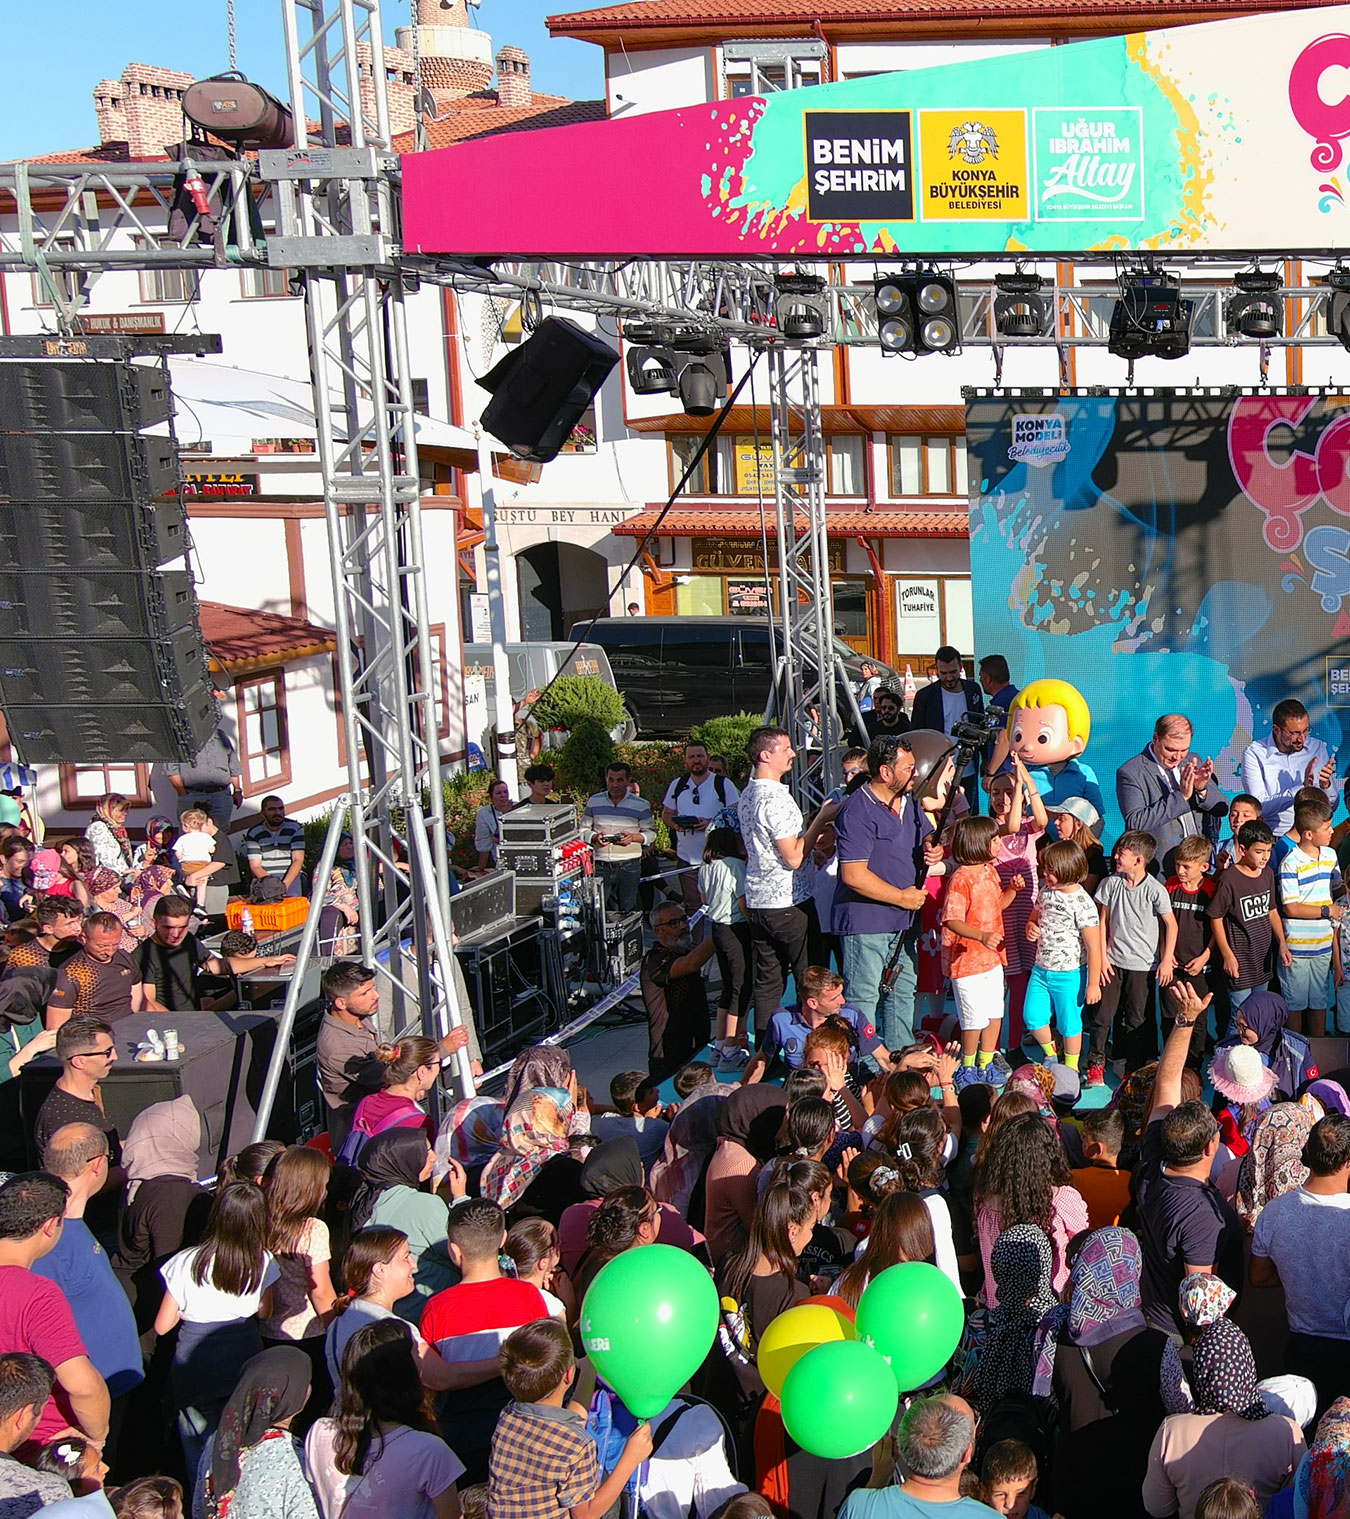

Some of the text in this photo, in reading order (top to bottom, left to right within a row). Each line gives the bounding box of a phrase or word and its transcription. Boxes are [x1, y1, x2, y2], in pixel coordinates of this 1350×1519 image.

[1061, 117, 1116, 138] UĞUR
[952, 170, 997, 182] KONYA
[1042, 156, 1137, 202] Altay
[930, 181, 1020, 201] BÜYÜKŞEHİR
[948, 199, 1002, 210] BELEDİYESİ
[1016, 420, 1062, 432] KONYA
[551, 511, 575, 522] BEY
[696, 550, 771, 570] GÜVEN
[901, 586, 935, 601] TORUNLAR
[903, 602, 935, 612] TUHAFİYE
